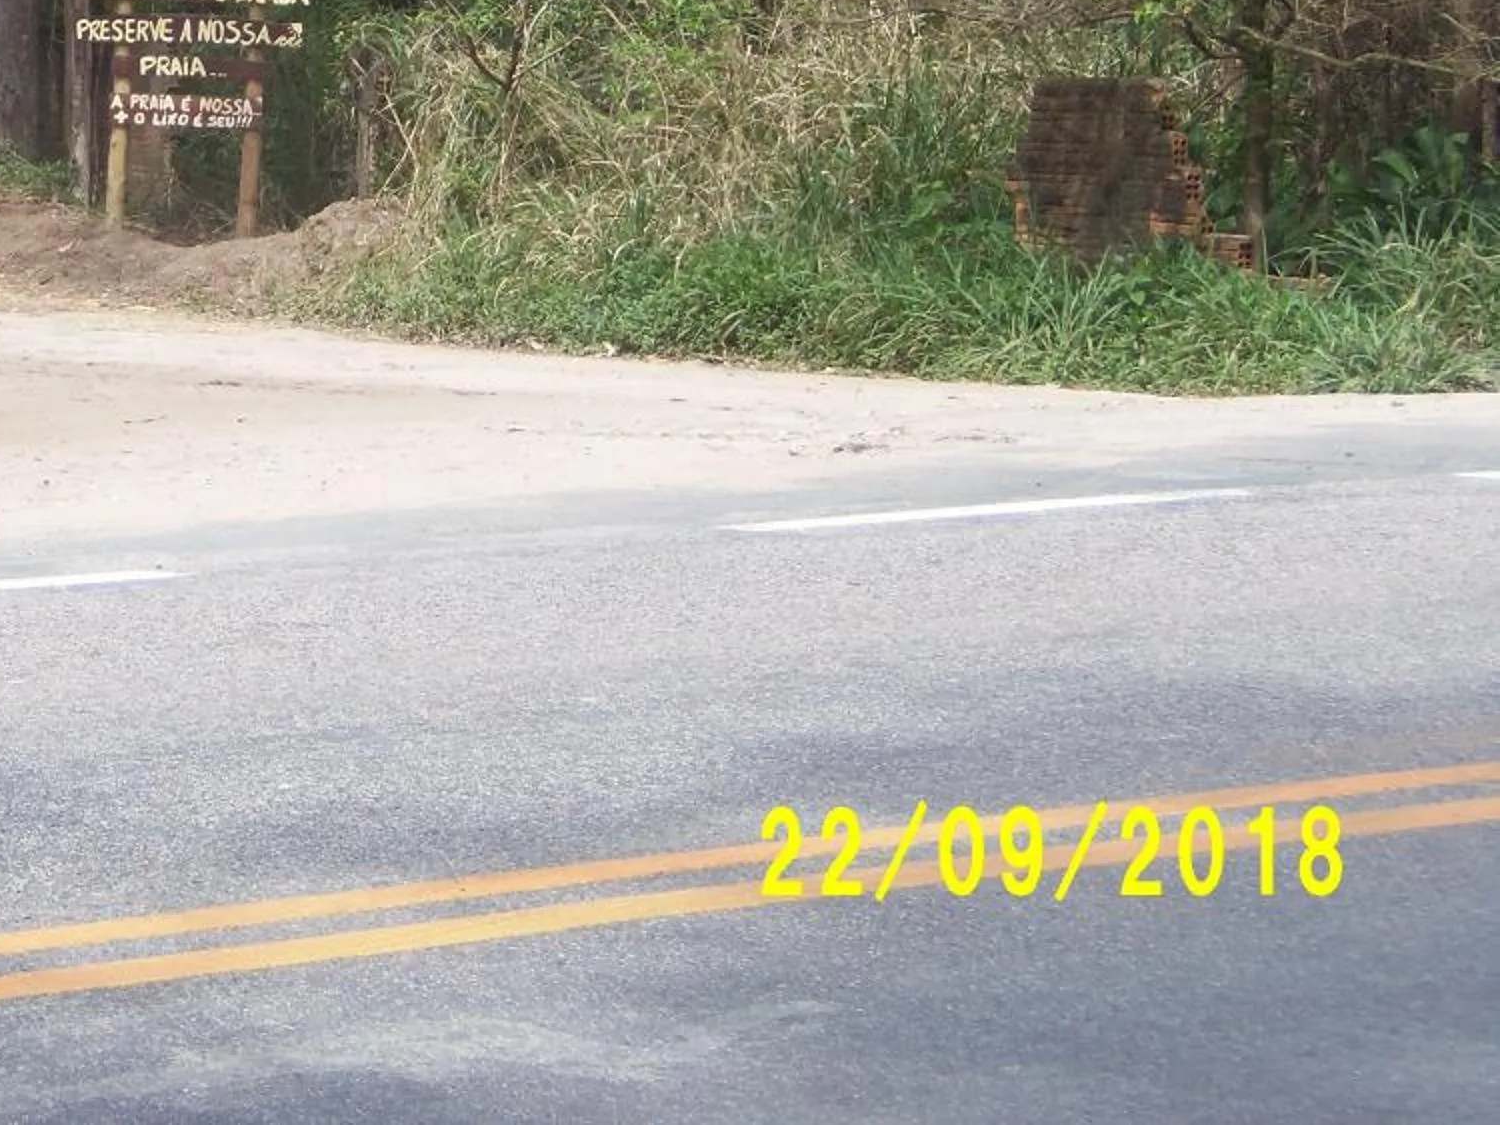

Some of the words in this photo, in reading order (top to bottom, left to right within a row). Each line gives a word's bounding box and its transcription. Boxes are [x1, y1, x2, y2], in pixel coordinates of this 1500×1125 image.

[76, 18, 175, 43] PRESERVE
[179, 18, 193, 44] A
[198, 18, 272, 46] NOSSA
[110, 94, 124, 110] A
[129, 93, 175, 112] PRAIA
[133, 112, 145, 124] O
[152, 111, 189, 126] LIXO
